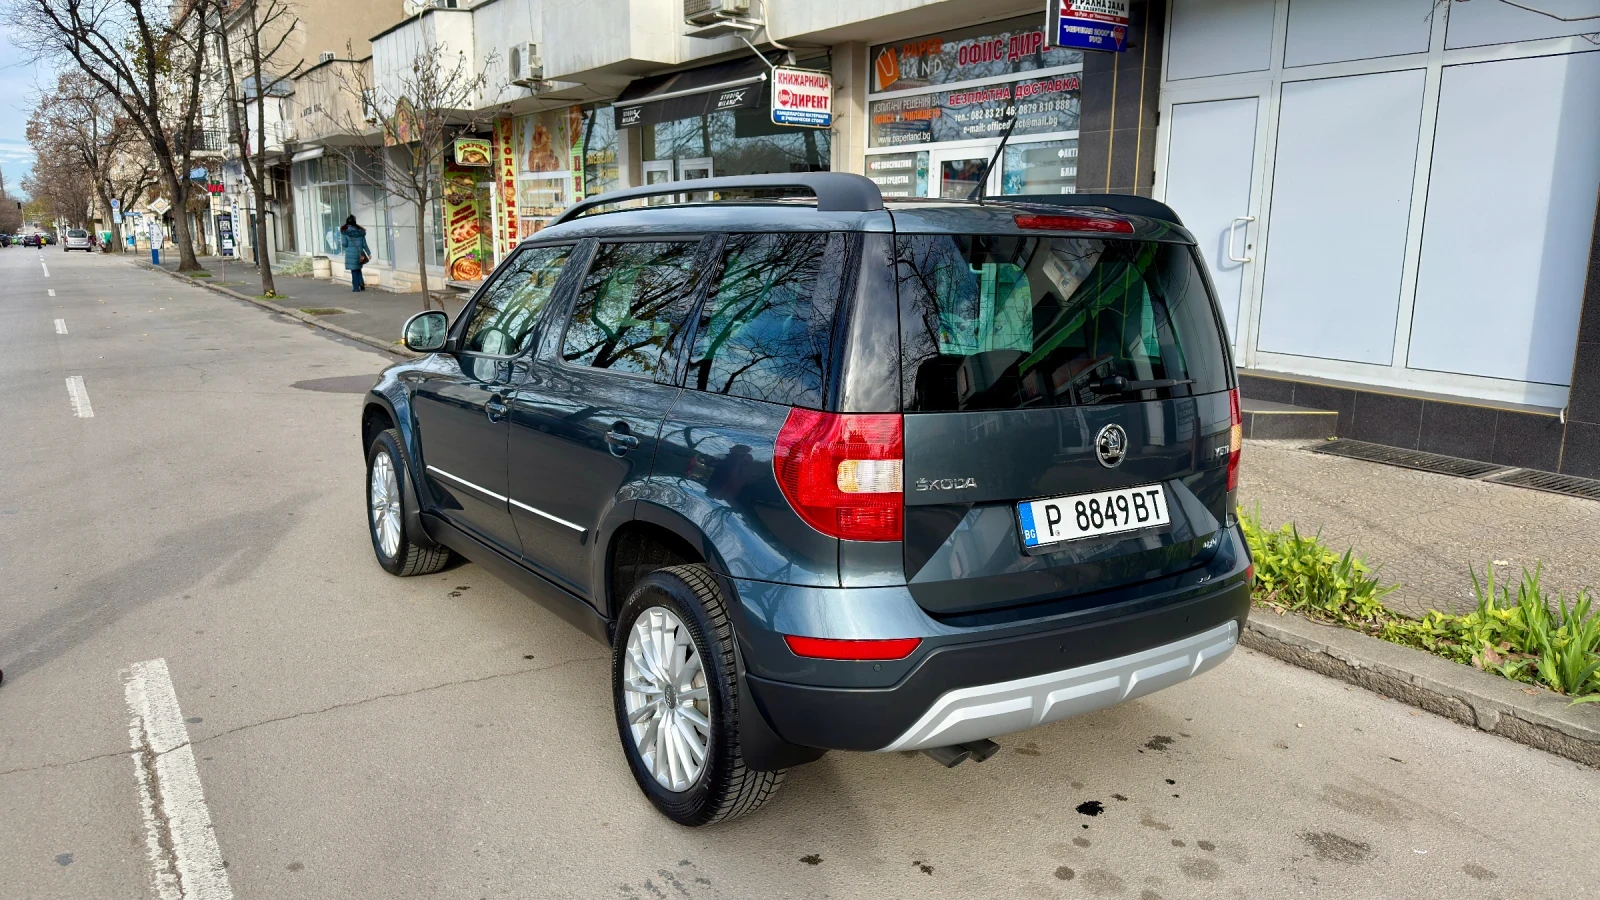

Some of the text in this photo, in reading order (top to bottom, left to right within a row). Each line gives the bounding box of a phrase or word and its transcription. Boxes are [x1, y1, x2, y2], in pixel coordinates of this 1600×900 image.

[1107, 0, 1125, 12] ЗАЛА
[902, 38, 942, 59] PAPER
[958, 38, 1003, 67] ОФИС
[901, 58, 942, 79] LAND
[777, 72, 829, 91] КНИЖАРНИЦА
[719, 92, 739, 101] STUDIO
[948, 77, 1079, 106] БЕЗПЛАТНА ДОСТАВКА
[790, 93, 829, 109] ДИРЕКТ
[873, 96, 940, 113] ИЗПИТАНИ РЕШЕНИЯ ЗА
[902, 108, 941, 121] УЧИЛИЩЕТО
[970, 111, 983, 121] 082
[984, 109, 994, 119] 83
[995, 108, 1004, 118] 21
[1018, 103, 1037, 115] 0879
[1039, 102, 1053, 112] 810
[1055, 99, 1070, 111] 888
[878, 131, 931, 143] www.paperland.bg
[963, 124, 986, 134] e-mail:
[458, 143, 488, 153] ЗАКУСКИ
[916, 477, 978, 491] ŠKODA
[1044, 504, 1061, 537] P
[1023, 529, 1036, 540] BG
